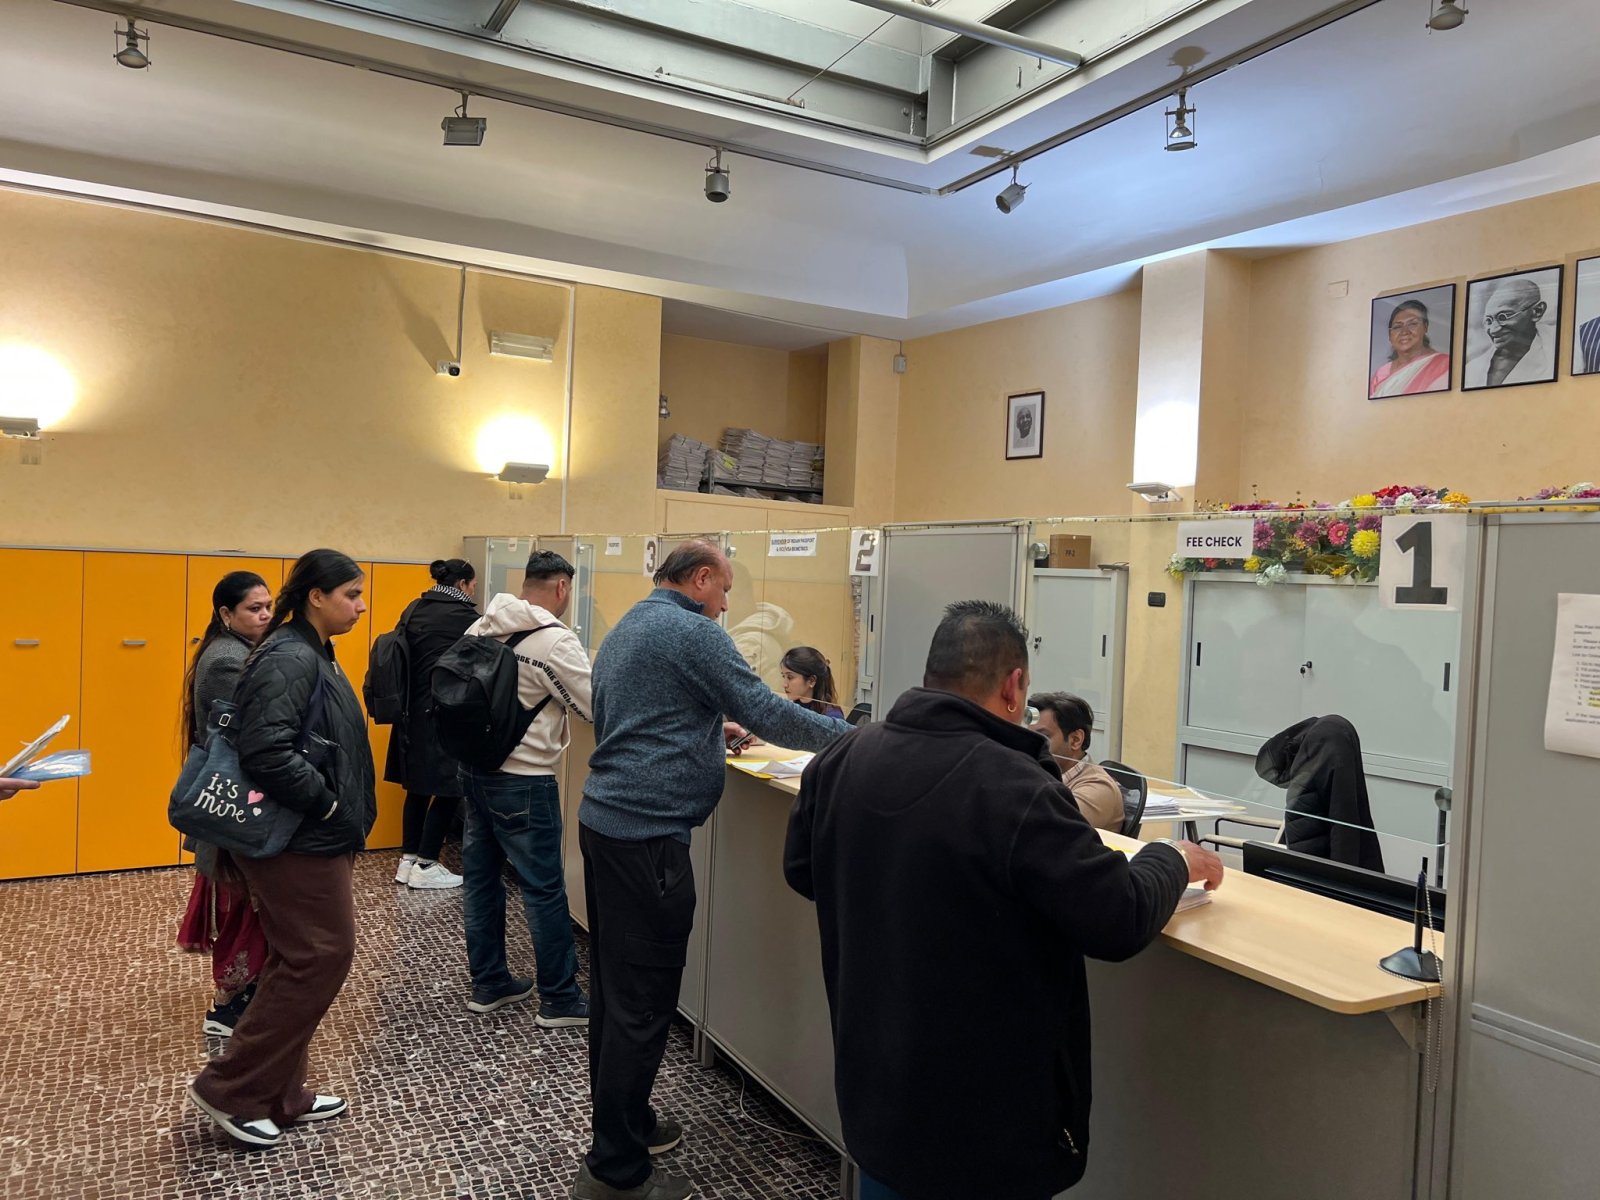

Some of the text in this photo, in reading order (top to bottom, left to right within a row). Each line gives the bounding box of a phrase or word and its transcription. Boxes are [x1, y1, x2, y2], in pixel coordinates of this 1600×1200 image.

[647, 540, 656, 573] 3
[855, 533, 875, 571] 2
[1186, 536, 1242, 547] FEE CHECK
[1395, 522, 1448, 604] 1
